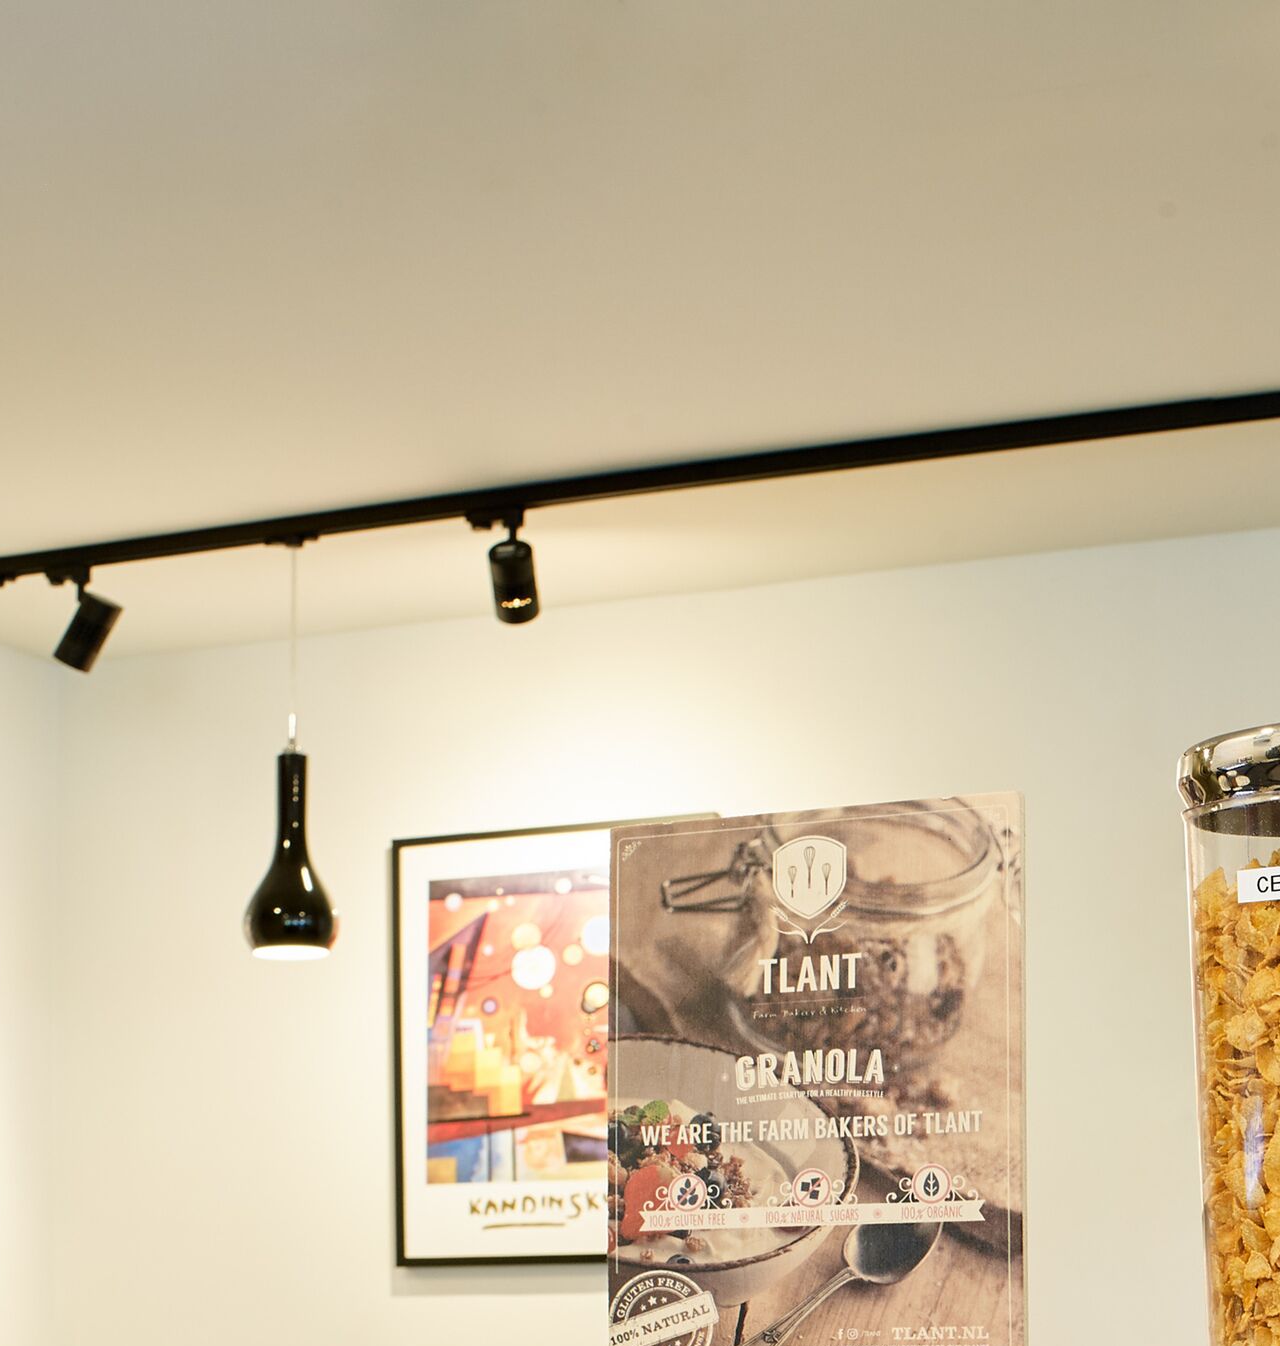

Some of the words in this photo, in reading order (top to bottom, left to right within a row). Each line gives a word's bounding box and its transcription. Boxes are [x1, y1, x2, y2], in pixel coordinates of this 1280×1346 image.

[758, 952, 862, 995] TLANT
[735, 1048, 885, 1092] GRANOLA
[641, 1124, 672, 1147] WE
[676, 1123, 713, 1145] ARE
[718, 1120, 754, 1143] THE
[758, 1118, 809, 1142] FARM
[814, 1112, 889, 1139] BAKERS
[894, 1112, 917, 1136] OF
[922, 1110, 983, 1135] TLANT
[675, 1213, 704, 1227] GLUTEN
[708, 1212, 726, 1226] FREE
[790, 1208, 825, 1224] NATURAL
[830, 1208, 860, 1222] SUGARS
[926, 1205, 963, 1219] ORGANIC
[616, 1277, 655, 1319] GLUTEN
[657, 1277, 692, 1296] FREE
[610, 1328, 639, 1346] 100%
[641, 1304, 710, 1336] NATURAL
[891, 1325, 990, 1340] TLANT.NL
